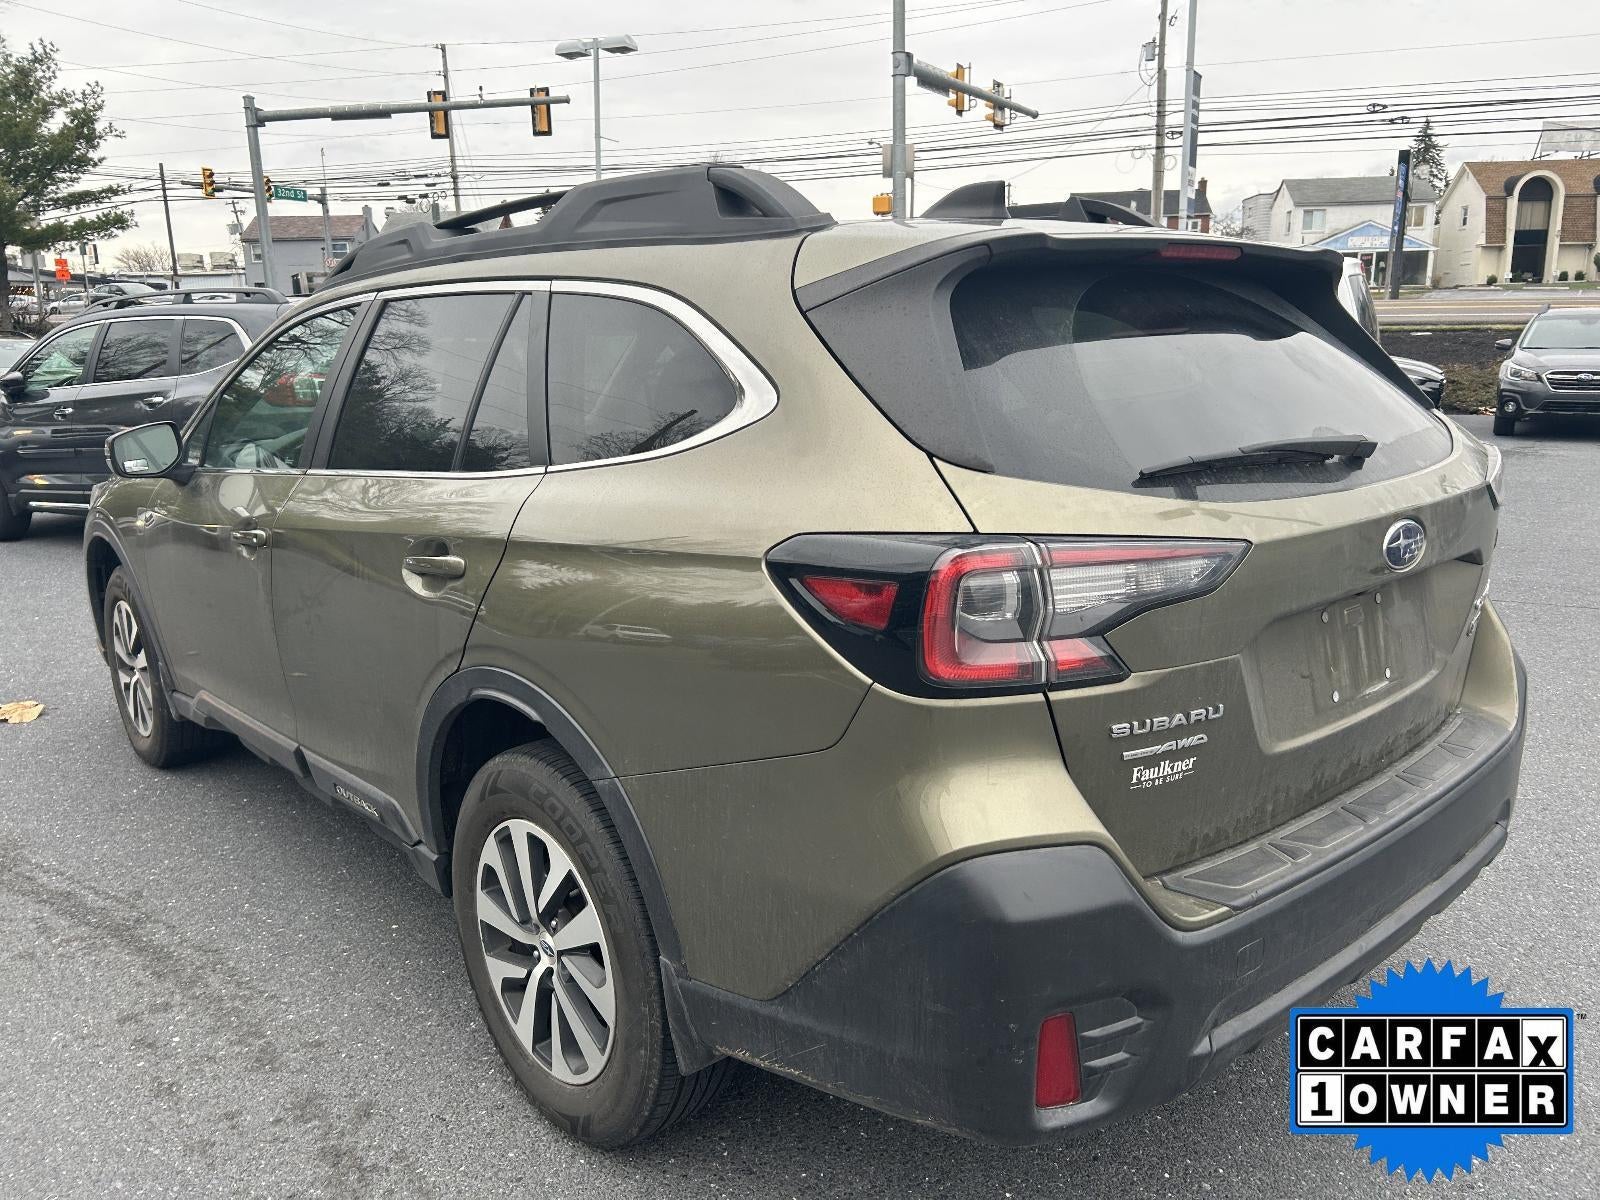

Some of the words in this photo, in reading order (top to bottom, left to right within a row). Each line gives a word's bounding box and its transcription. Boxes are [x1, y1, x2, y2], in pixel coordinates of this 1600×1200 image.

[277, 188, 295, 198] 32nd
[296, 190, 305, 199] St
[1110, 703, 1224, 738] SUBARU
[1156, 734, 1208, 754] AWD
[1131, 757, 1197, 783] Faulkner
[1166, 772, 1183, 782] SURE
[336, 785, 378, 817] OUTBACK
